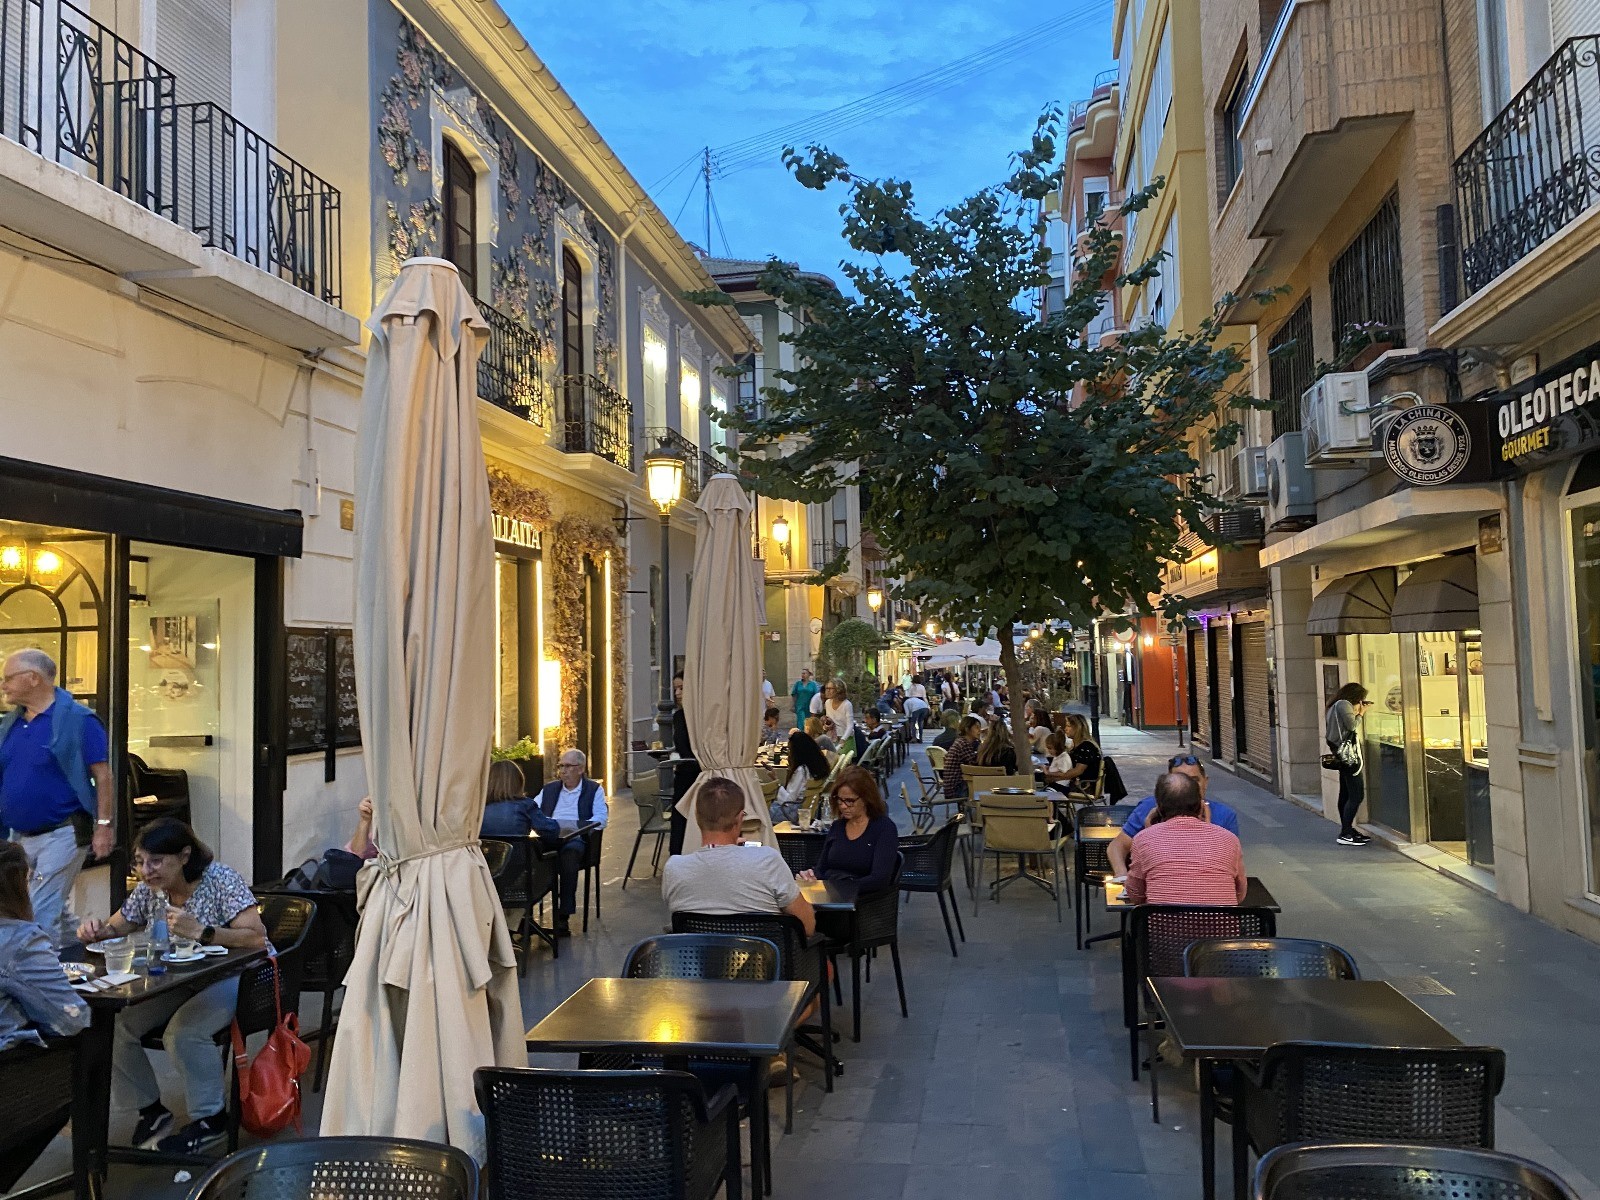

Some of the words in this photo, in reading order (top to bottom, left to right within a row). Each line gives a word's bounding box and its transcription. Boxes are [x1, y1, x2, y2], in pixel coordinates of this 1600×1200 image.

[1498, 360, 1600, 438] OLEOTECA
[1394, 417, 1409, 430] LA
[1408, 408, 1454, 426] CHINATA
[1388, 440, 1409, 474] MAESTROS
[1447, 451, 1465, 472] DESDE
[1501, 426, 1550, 461] GOURMET
